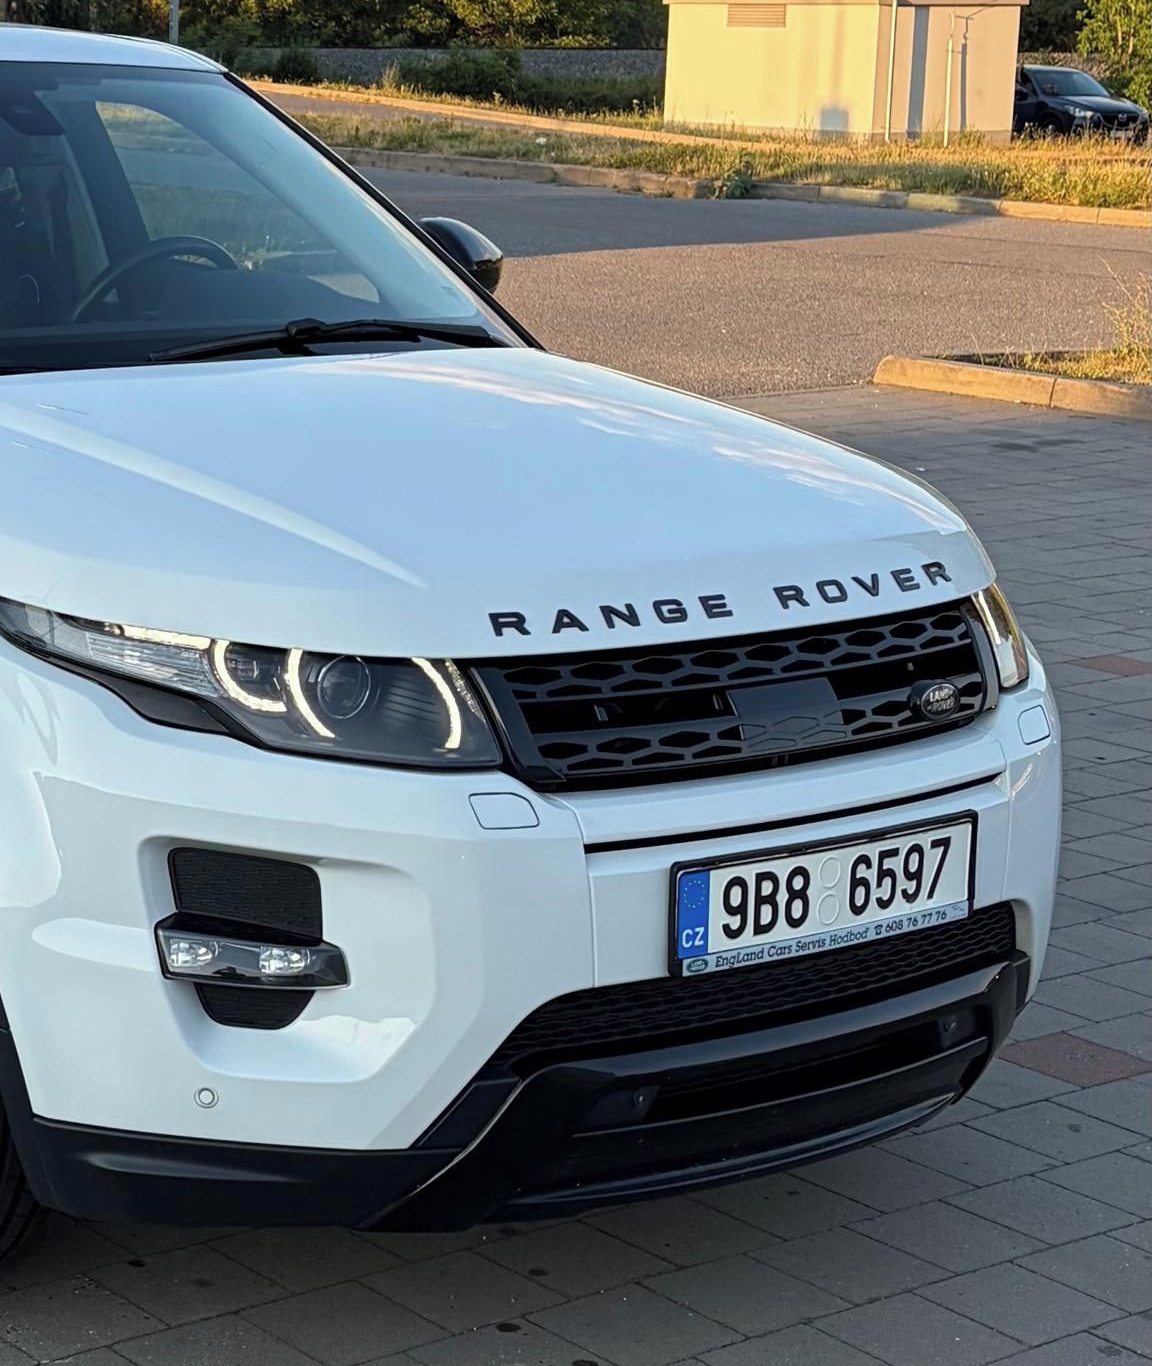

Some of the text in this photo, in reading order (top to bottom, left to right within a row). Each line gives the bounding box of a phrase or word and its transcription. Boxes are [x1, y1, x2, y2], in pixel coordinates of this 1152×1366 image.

[488, 561, 953, 637] RANGE ROVER
[721, 835, 952, 940] 9B8 6597
[681, 926, 706, 949] CZ
[767, 943, 793, 958] Cars
[795, 937, 827, 953] Servis
[884, 919, 904, 933] 608
[906, 917, 919, 928] 76
[920, 913, 934, 925] 77
[934, 909, 948, 922] 76
